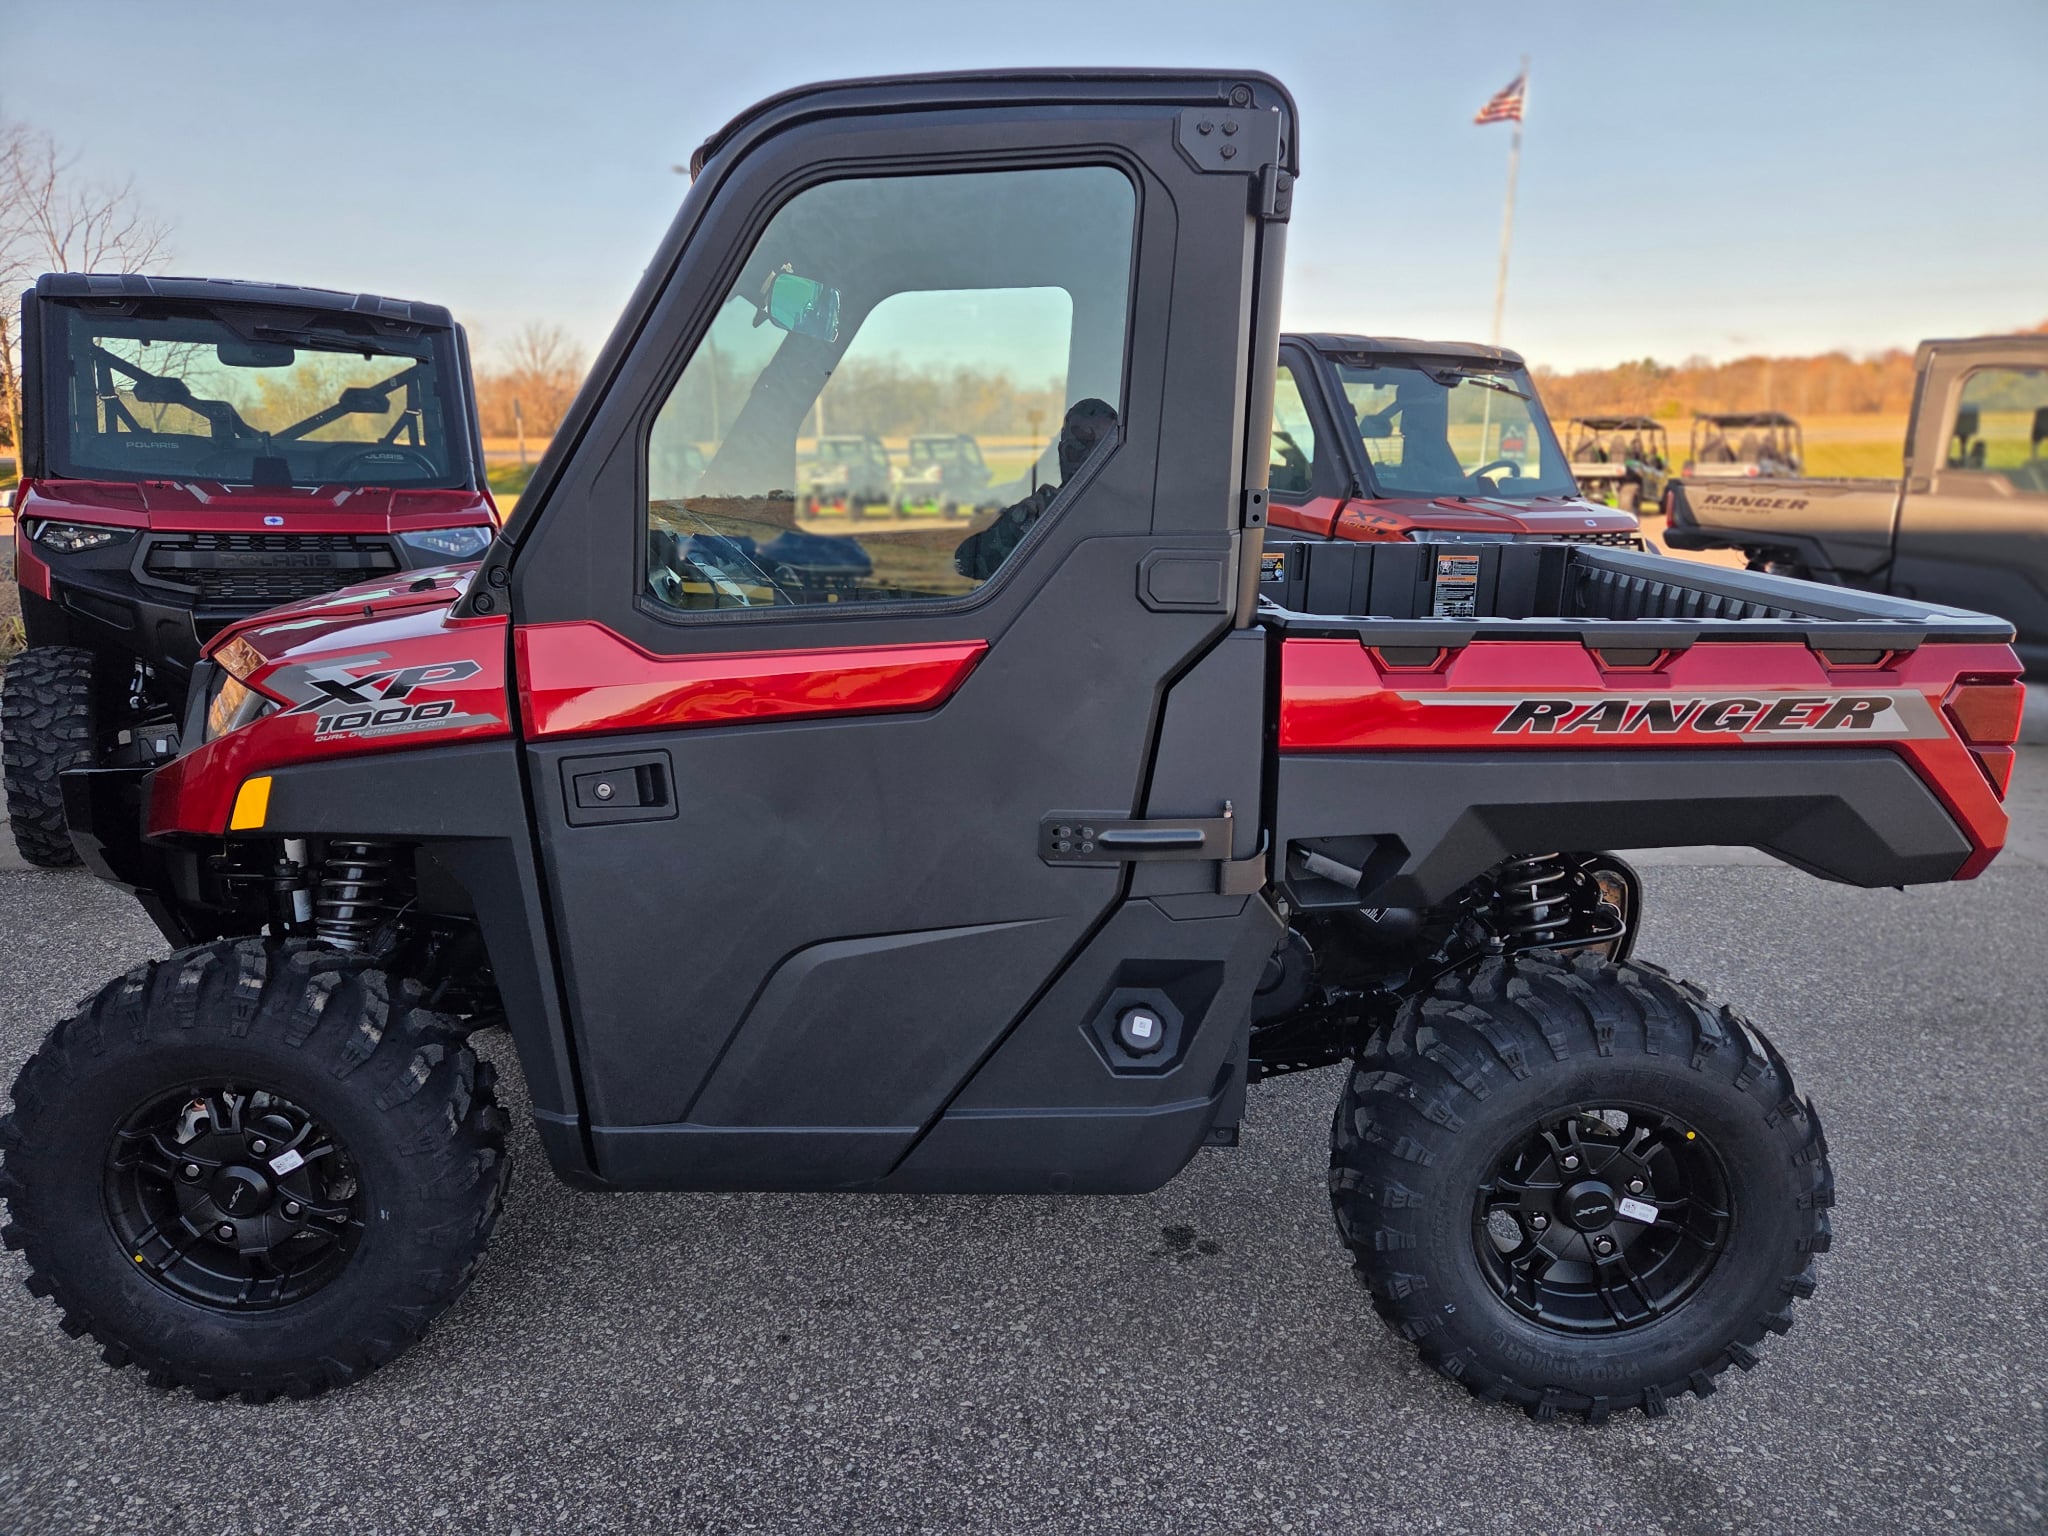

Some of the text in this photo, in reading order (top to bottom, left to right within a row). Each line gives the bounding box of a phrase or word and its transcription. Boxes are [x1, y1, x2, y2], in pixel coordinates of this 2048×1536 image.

[1703, 494, 1809, 510] RANGER
[1347, 509, 1398, 525] XP
[1343, 519, 1379, 535] 1000
[218, 553, 333, 568] POLARIS
[276, 659, 483, 718] XP
[314, 699, 455, 736] 1000
[1492, 695, 1896, 734] RANGER
[315, 720, 446, 743] DUAL OVERHEAD CAM
[1575, 1205, 1608, 1217] XP
